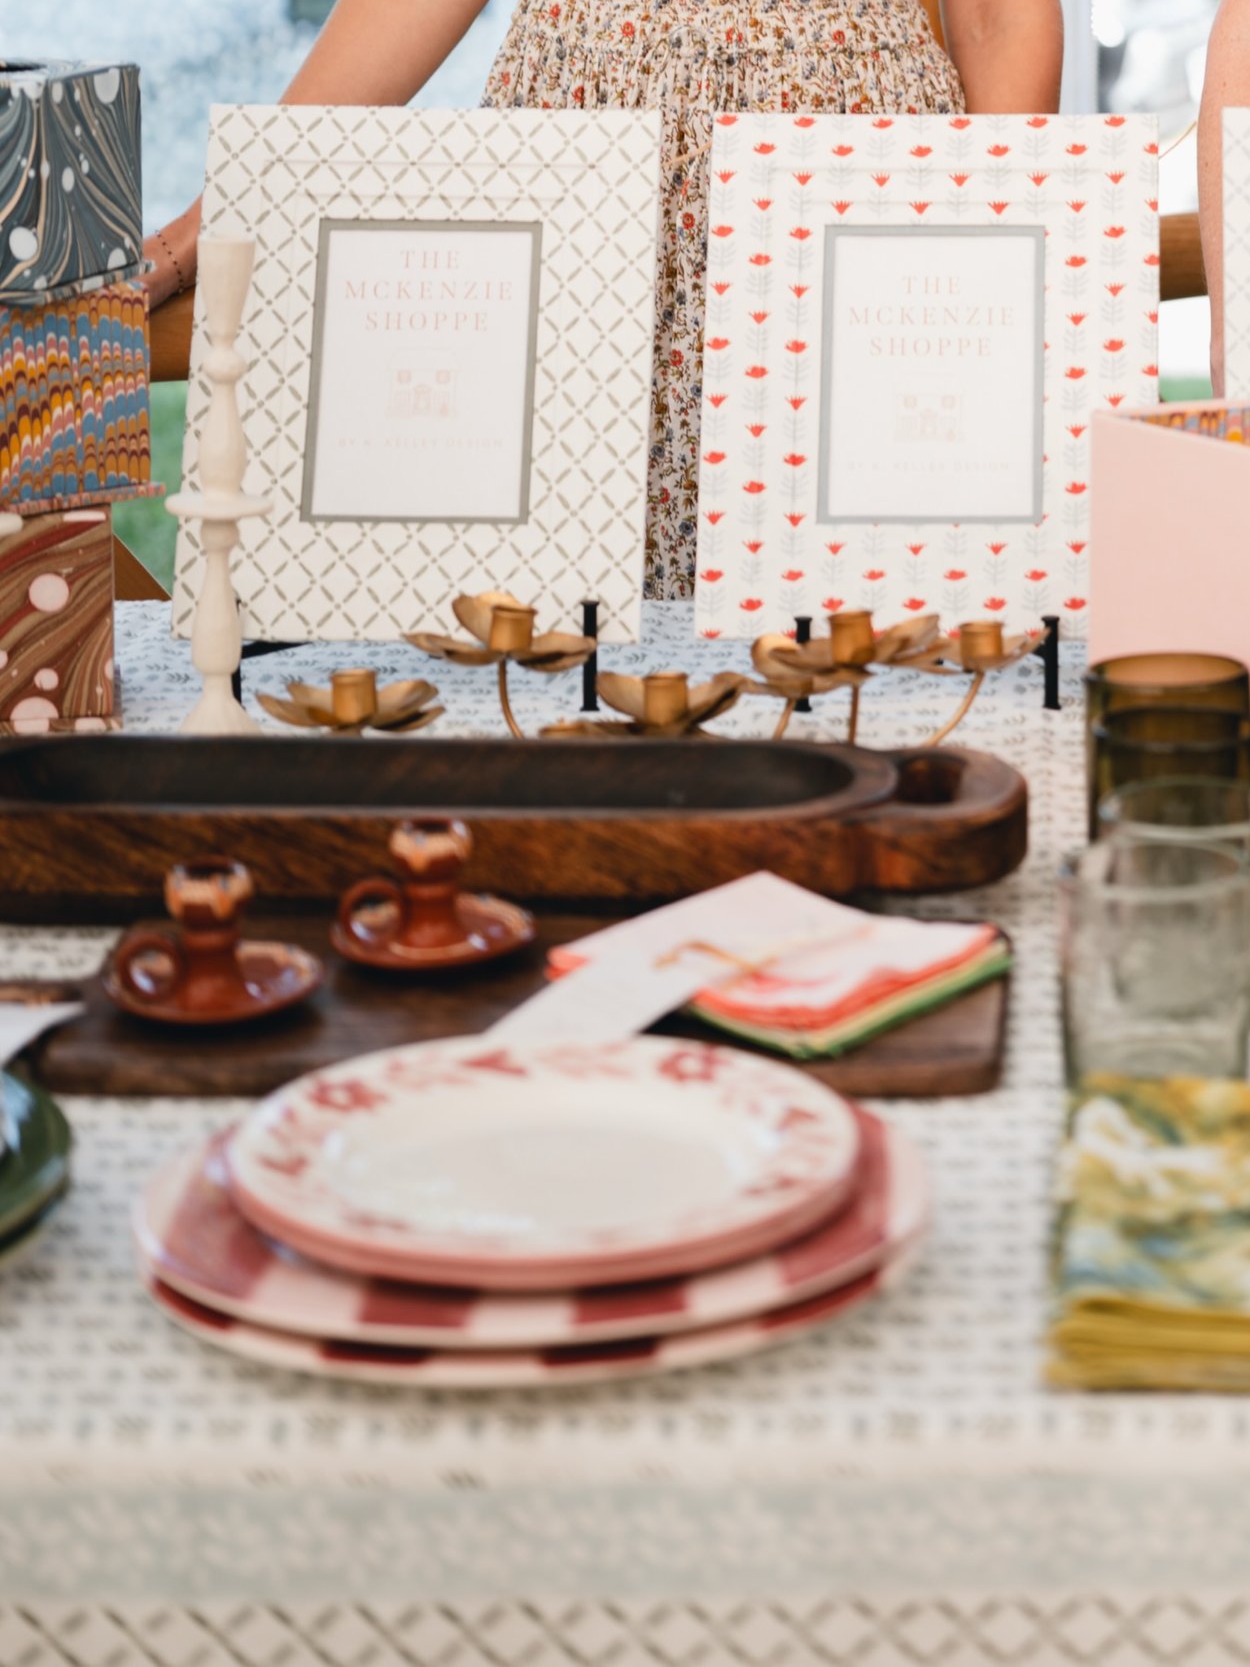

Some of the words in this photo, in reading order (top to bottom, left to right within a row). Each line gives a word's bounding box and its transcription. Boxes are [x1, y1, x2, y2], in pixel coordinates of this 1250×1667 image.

[400, 249, 460, 270] THE
[344, 280, 513, 301] MCKENZIE
[902, 275, 961, 295] THE
[364, 311, 489, 332] SHOPPE
[847, 306, 1015, 327] MCKENZIE
[868, 337, 993, 357] SHOPPE
